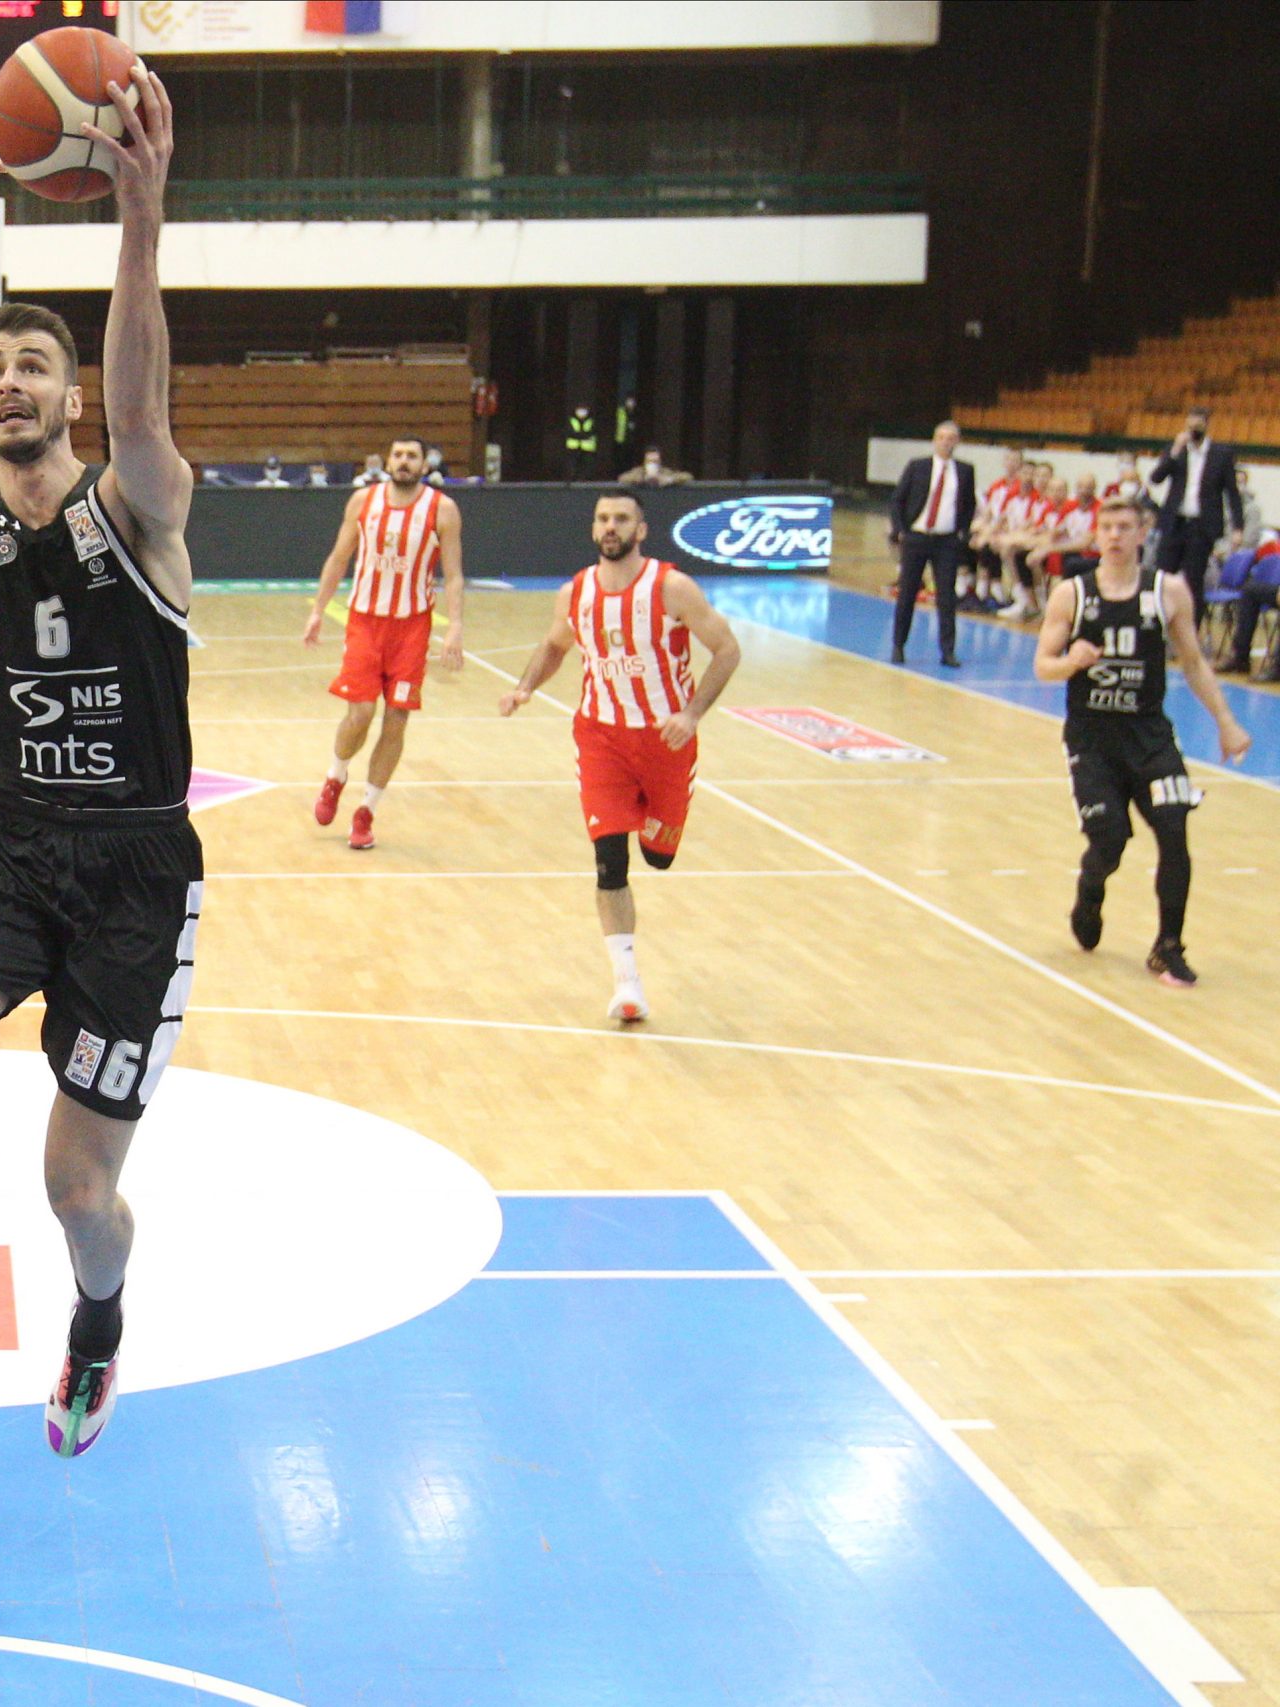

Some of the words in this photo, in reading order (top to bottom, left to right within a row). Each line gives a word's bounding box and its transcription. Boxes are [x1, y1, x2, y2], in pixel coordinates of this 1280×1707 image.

[35, 595, 70, 659] 6
[1102, 626, 1137, 657] 10
[598, 656, 645, 681] mts
[71, 683, 122, 708] NIS
[20, 734, 115, 775] mts
[98, 1039, 142, 1101] 6
